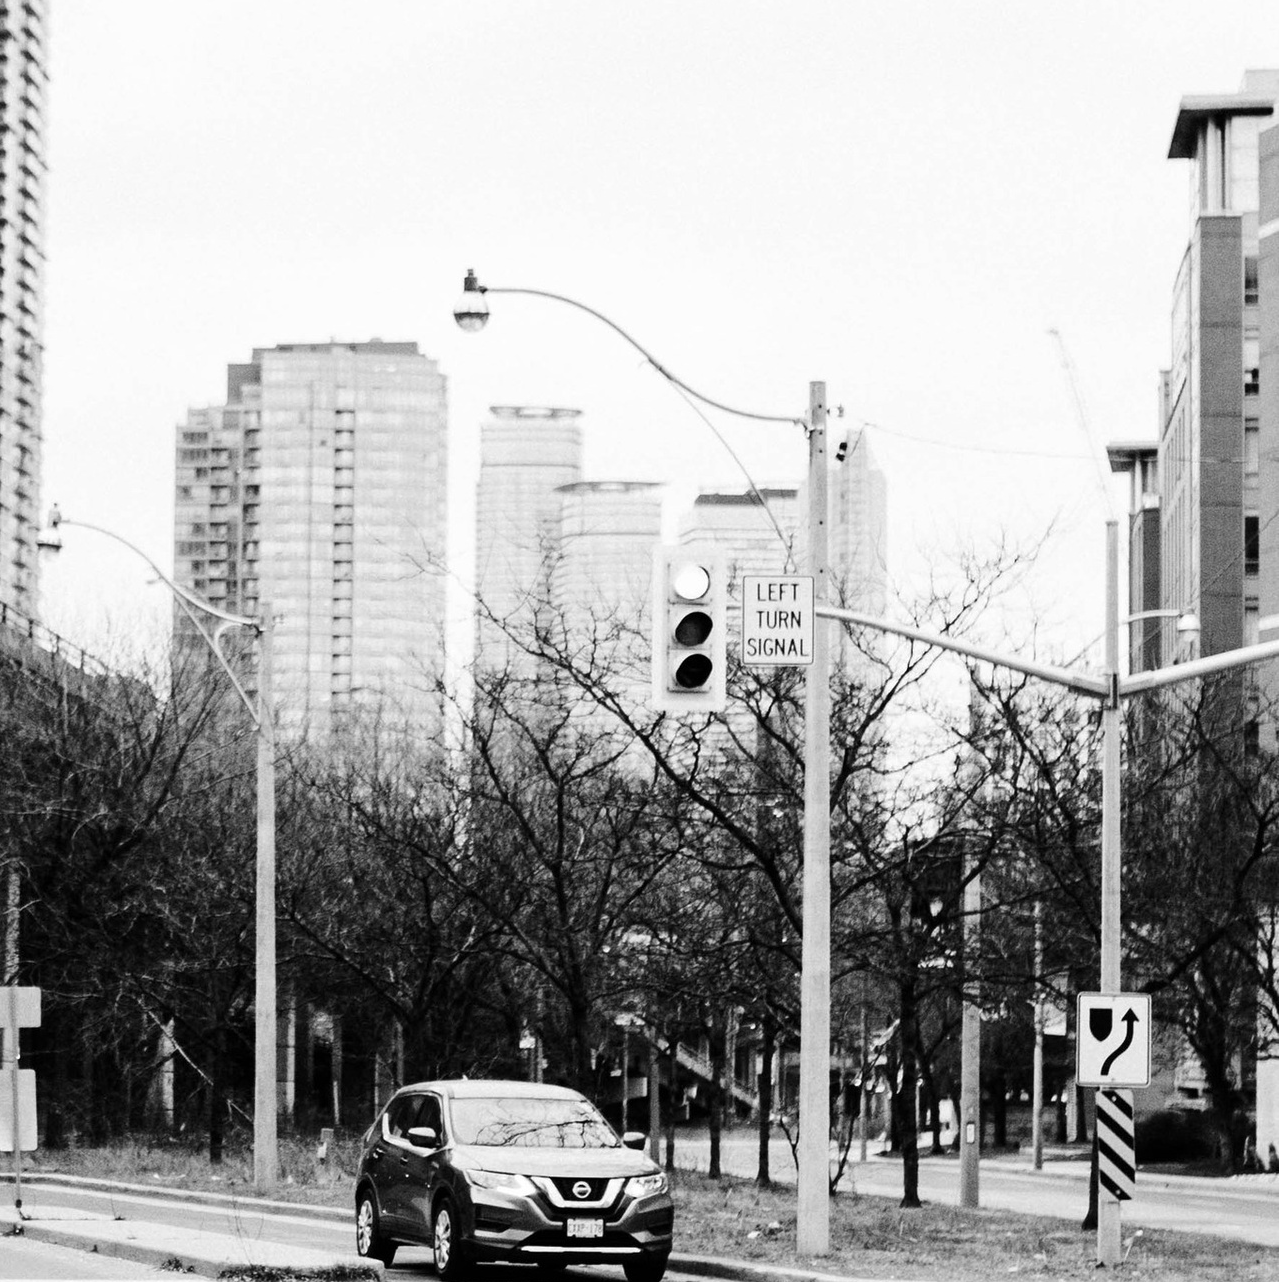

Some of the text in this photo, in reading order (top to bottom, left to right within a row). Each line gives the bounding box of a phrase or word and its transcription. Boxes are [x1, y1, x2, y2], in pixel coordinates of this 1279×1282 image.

[757, 583, 800, 601] LEFT
[756, 610, 802, 629] TURN
[747, 637, 809, 657] SIGNAL
